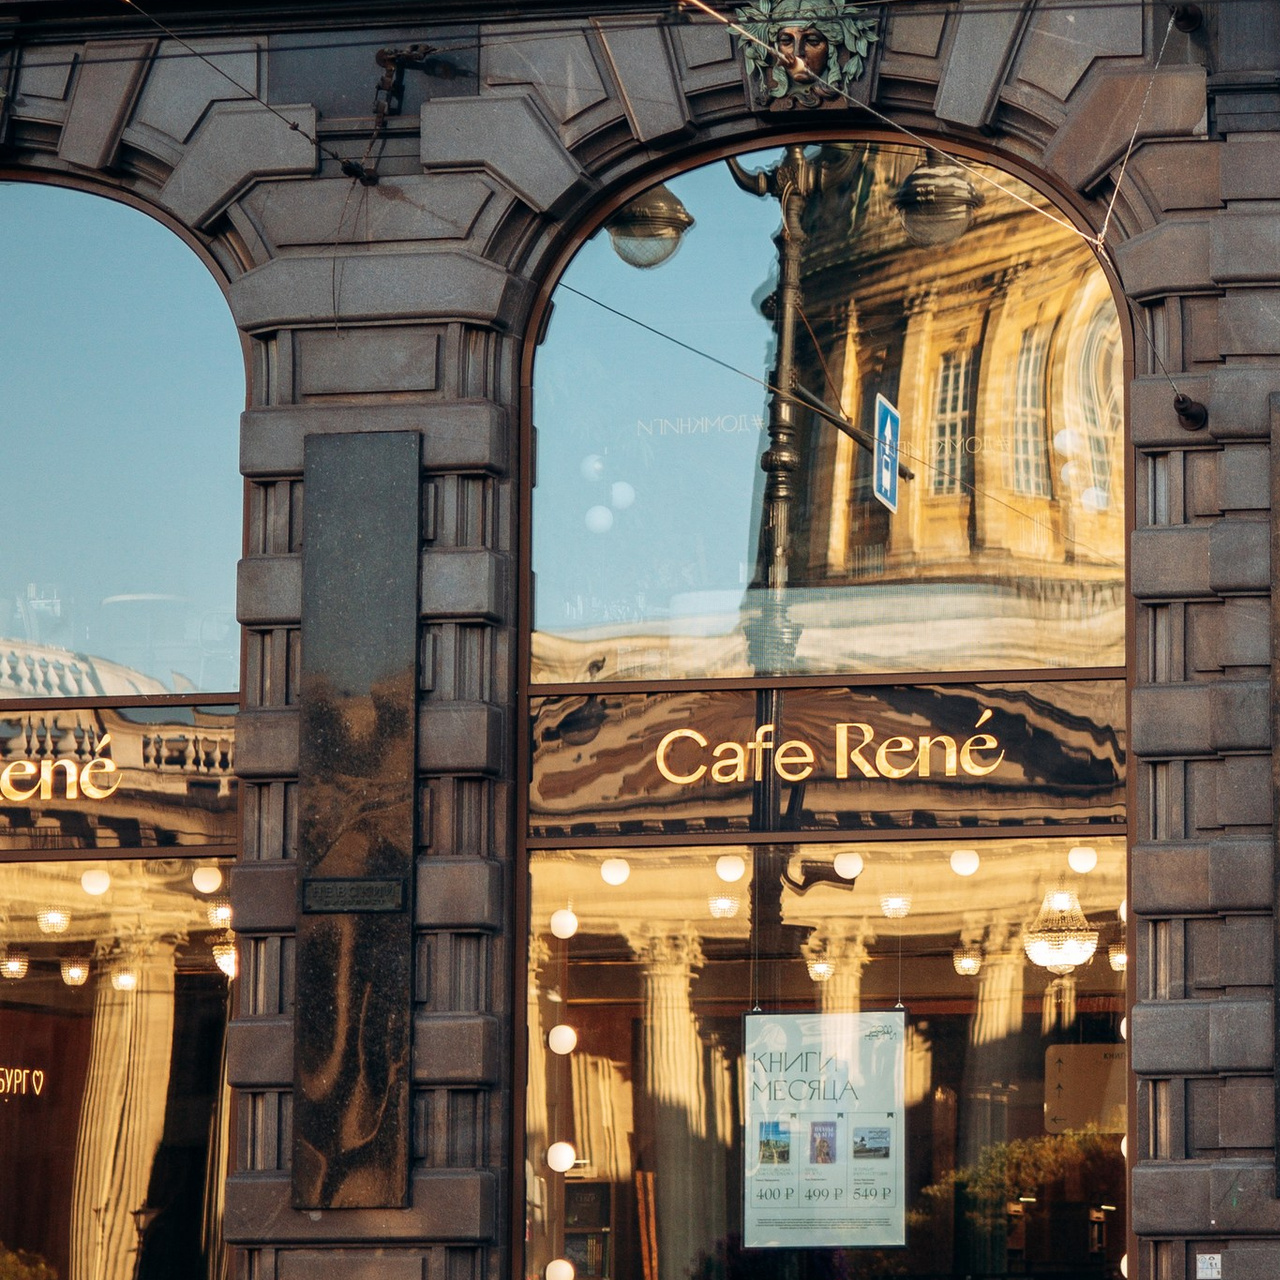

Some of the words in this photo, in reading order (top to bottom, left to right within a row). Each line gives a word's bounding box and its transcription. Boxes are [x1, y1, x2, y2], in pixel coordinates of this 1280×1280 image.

[655, 724, 815, 785] Cafe
[835, 708, 1006, 781] René
[0, 733, 123, 802] ené
[752, 1051, 839, 1074] КНИГИ
[752, 1078, 859, 1104] МЕСЯЦА
[756, 1187, 781, 1201] 400
[804, 1187, 830, 1201] 499
[853, 1187, 878, 1201] 549
